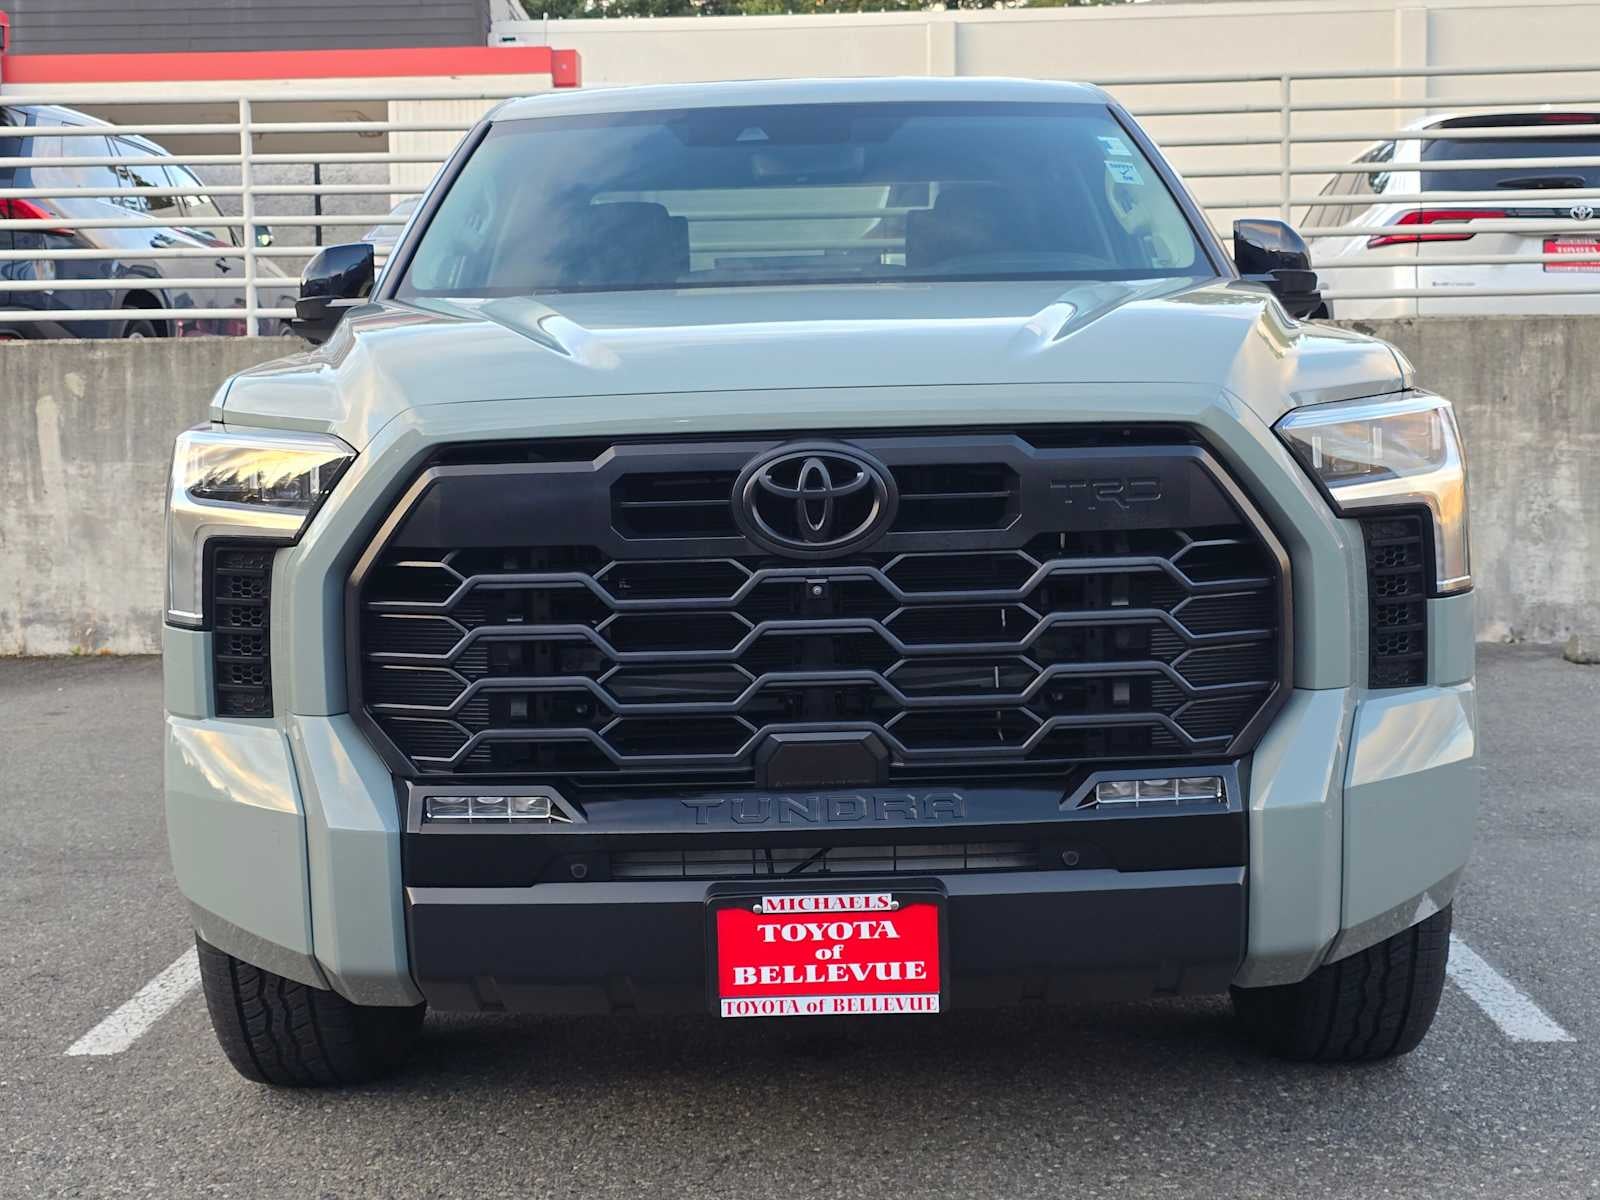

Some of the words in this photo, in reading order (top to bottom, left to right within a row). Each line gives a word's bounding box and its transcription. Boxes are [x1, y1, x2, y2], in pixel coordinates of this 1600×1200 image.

[1050, 480, 1162, 510] TRD
[681, 792, 966, 824] TUNDRA
[766, 896, 890, 911] MICHAELS
[757, 920, 900, 943] TOYOTA
[815, 945, 844, 960] of
[733, 961, 927, 986] BELLEVUE
[724, 999, 799, 1016] TOYOTA
[807, 998, 825, 1013] of
[833, 996, 938, 1013] BELLEVUE
